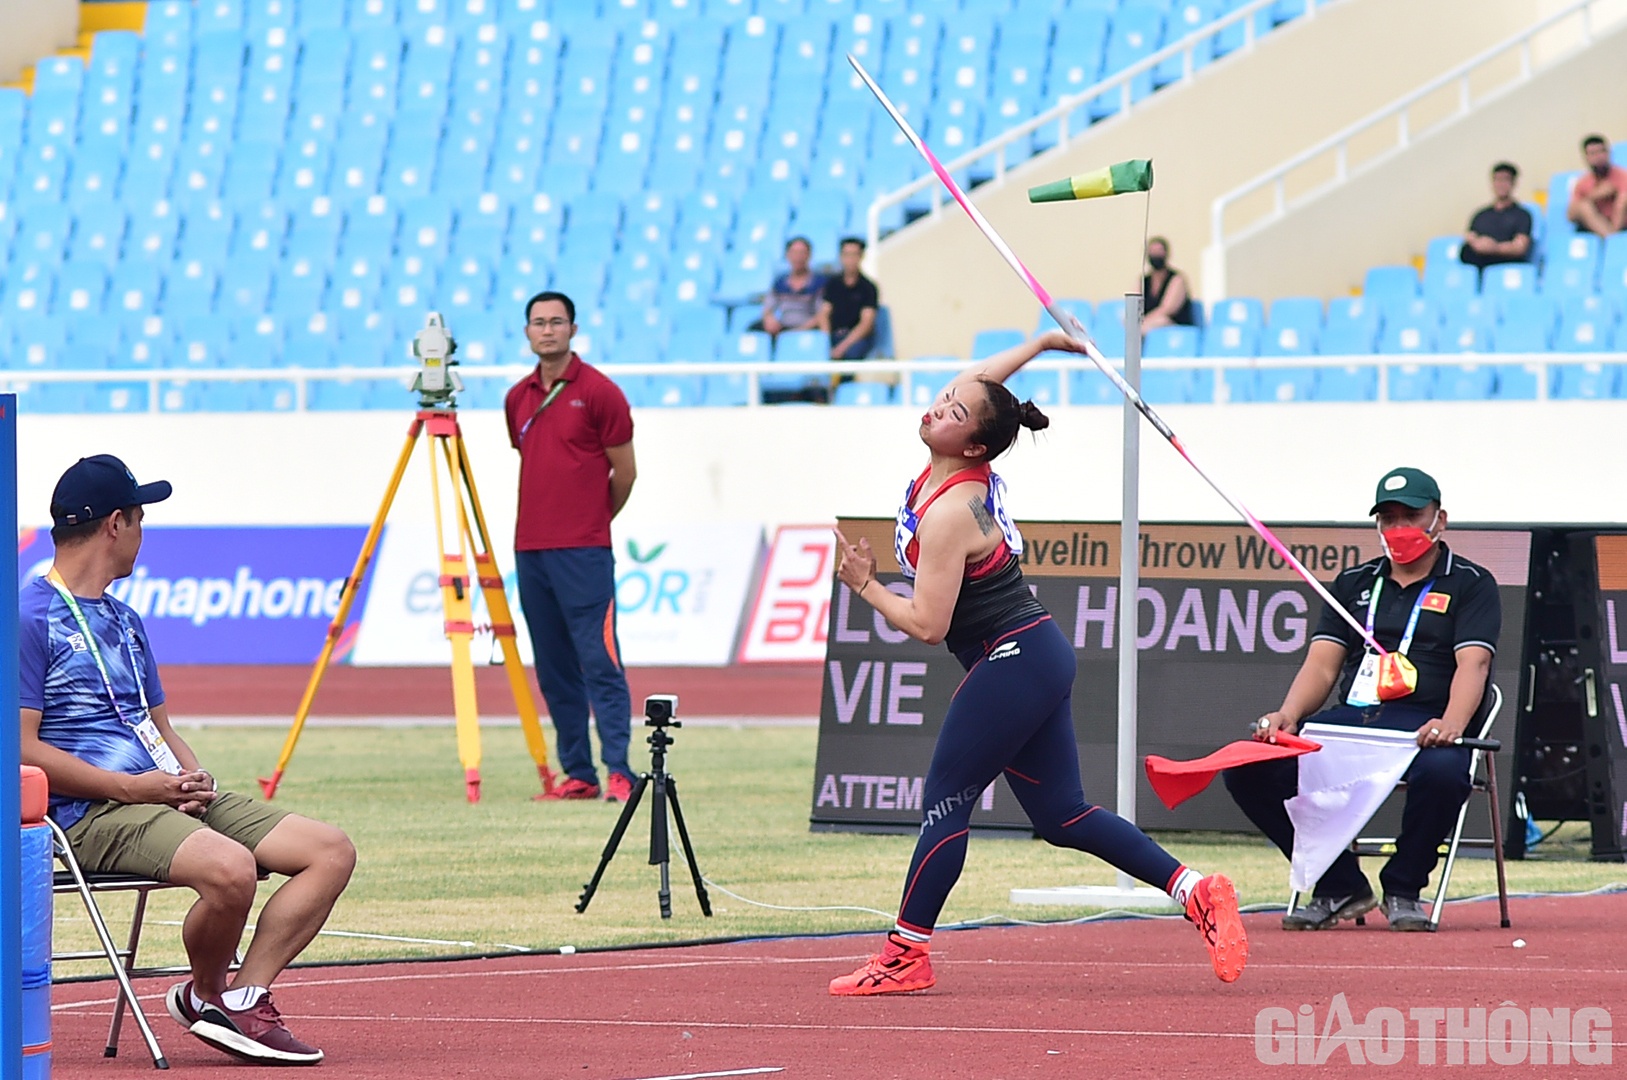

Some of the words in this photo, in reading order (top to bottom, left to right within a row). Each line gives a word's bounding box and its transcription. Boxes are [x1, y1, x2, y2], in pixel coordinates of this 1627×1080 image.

[1019, 531, 1109, 567] avelin
[104, 565, 346, 627] vinaphone
[1073, 585, 1309, 653] HOANG
[829, 661, 927, 725] VIE
[816, 774, 924, 811] ATTEM
